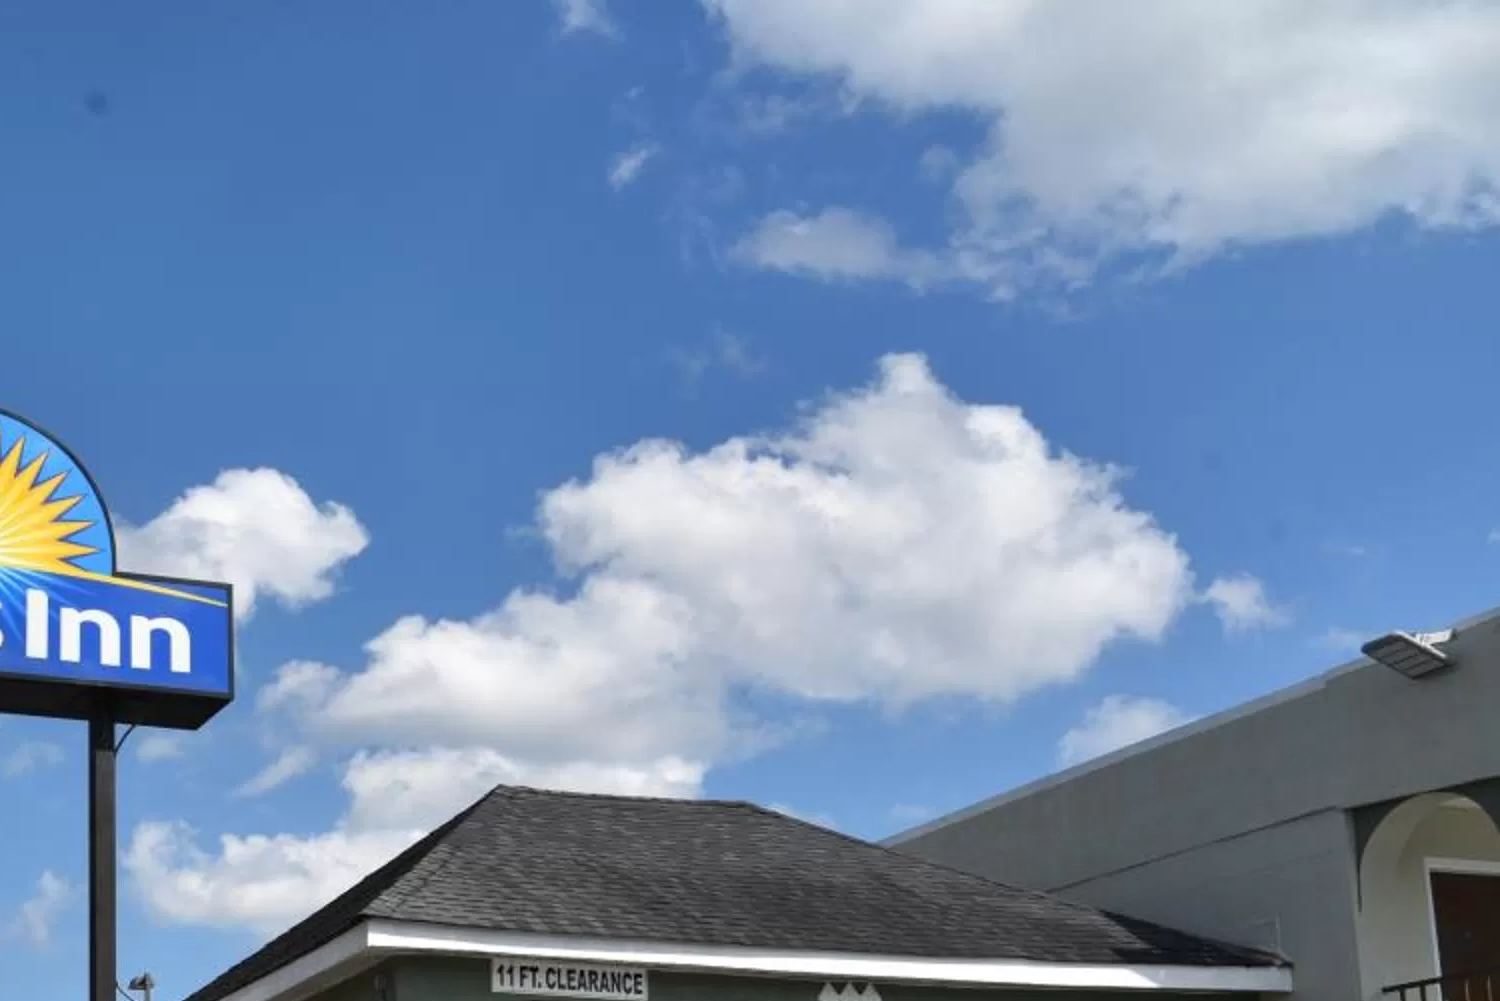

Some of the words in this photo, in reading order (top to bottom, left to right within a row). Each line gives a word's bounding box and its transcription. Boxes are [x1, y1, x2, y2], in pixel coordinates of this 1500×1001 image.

[25, 588, 192, 674] Inn
[497, 964, 514, 987] 11
[519, 965, 542, 989] FT.
[545, 967, 643, 995] CLEARANCE
